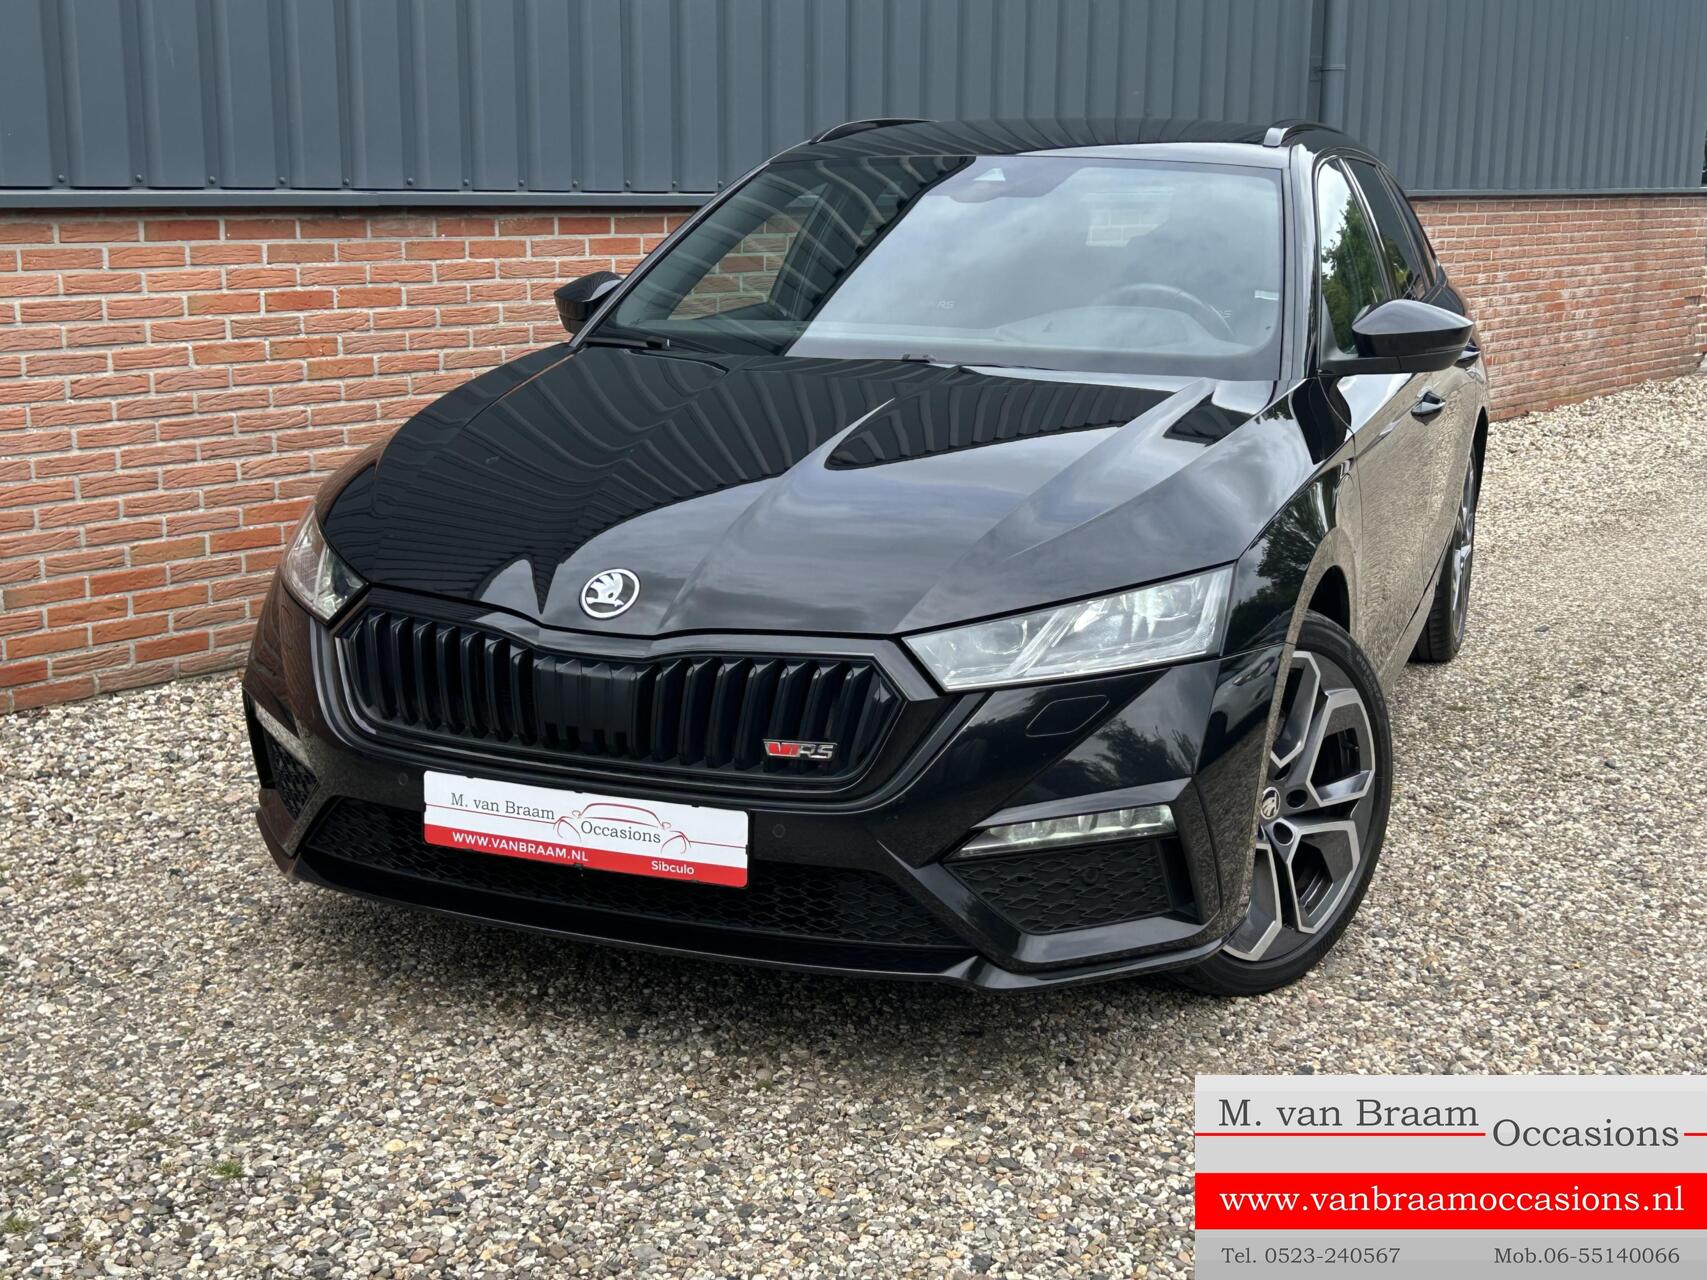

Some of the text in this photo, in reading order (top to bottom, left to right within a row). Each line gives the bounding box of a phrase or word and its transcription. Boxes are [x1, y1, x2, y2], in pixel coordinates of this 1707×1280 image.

[450, 792, 556, 820] M. van Braam
[580, 820, 662, 844] Occasions
[451, 831, 589, 862] WWW.VANBRAAM.NL
[650, 860, 695, 876] Sibculo
